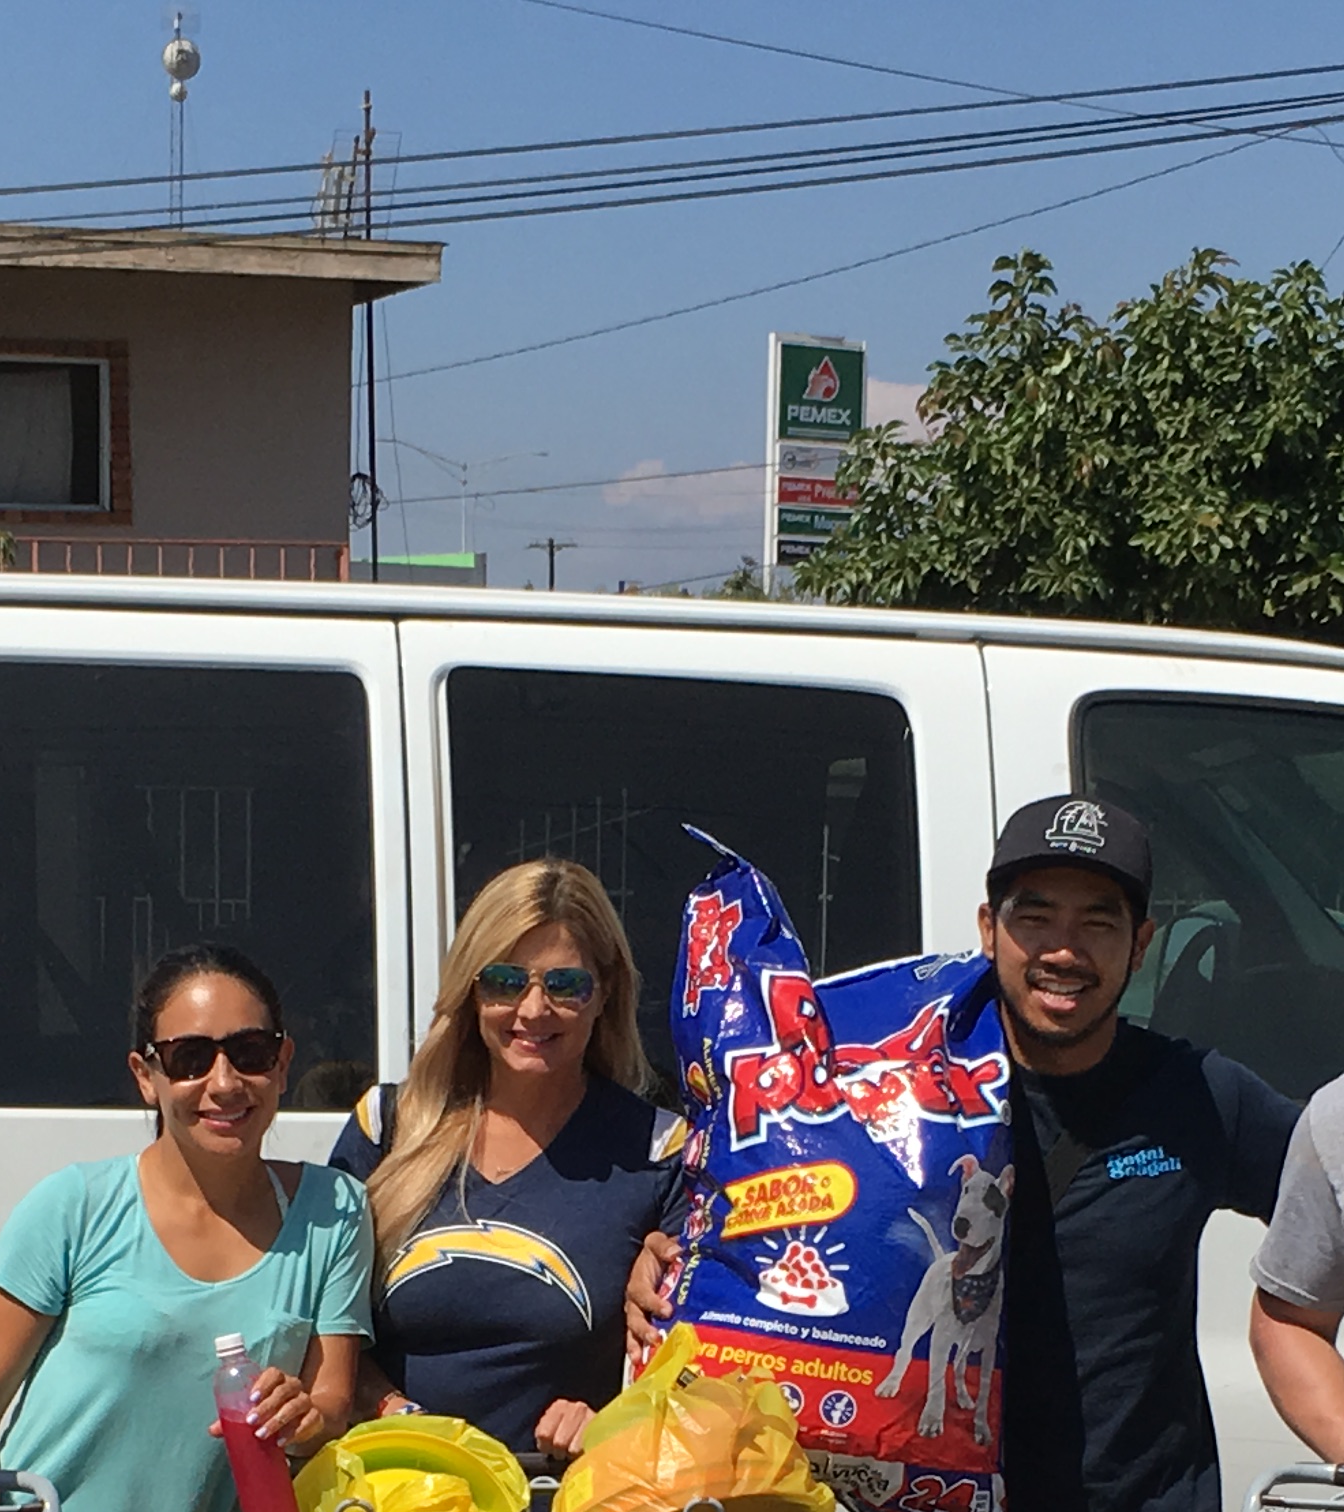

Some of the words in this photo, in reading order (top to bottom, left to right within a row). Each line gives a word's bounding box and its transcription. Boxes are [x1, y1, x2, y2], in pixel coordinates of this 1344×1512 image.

[787, 405, 851, 425] PEMEX
[743, 1317, 798, 1335] completo
[800, 1326, 810, 1338] y
[812, 1326, 887, 1348] balanceado
[699, 1343, 717, 1358] ra
[719, 1346, 786, 1372] perros
[791, 1358, 874, 1385] adultos
